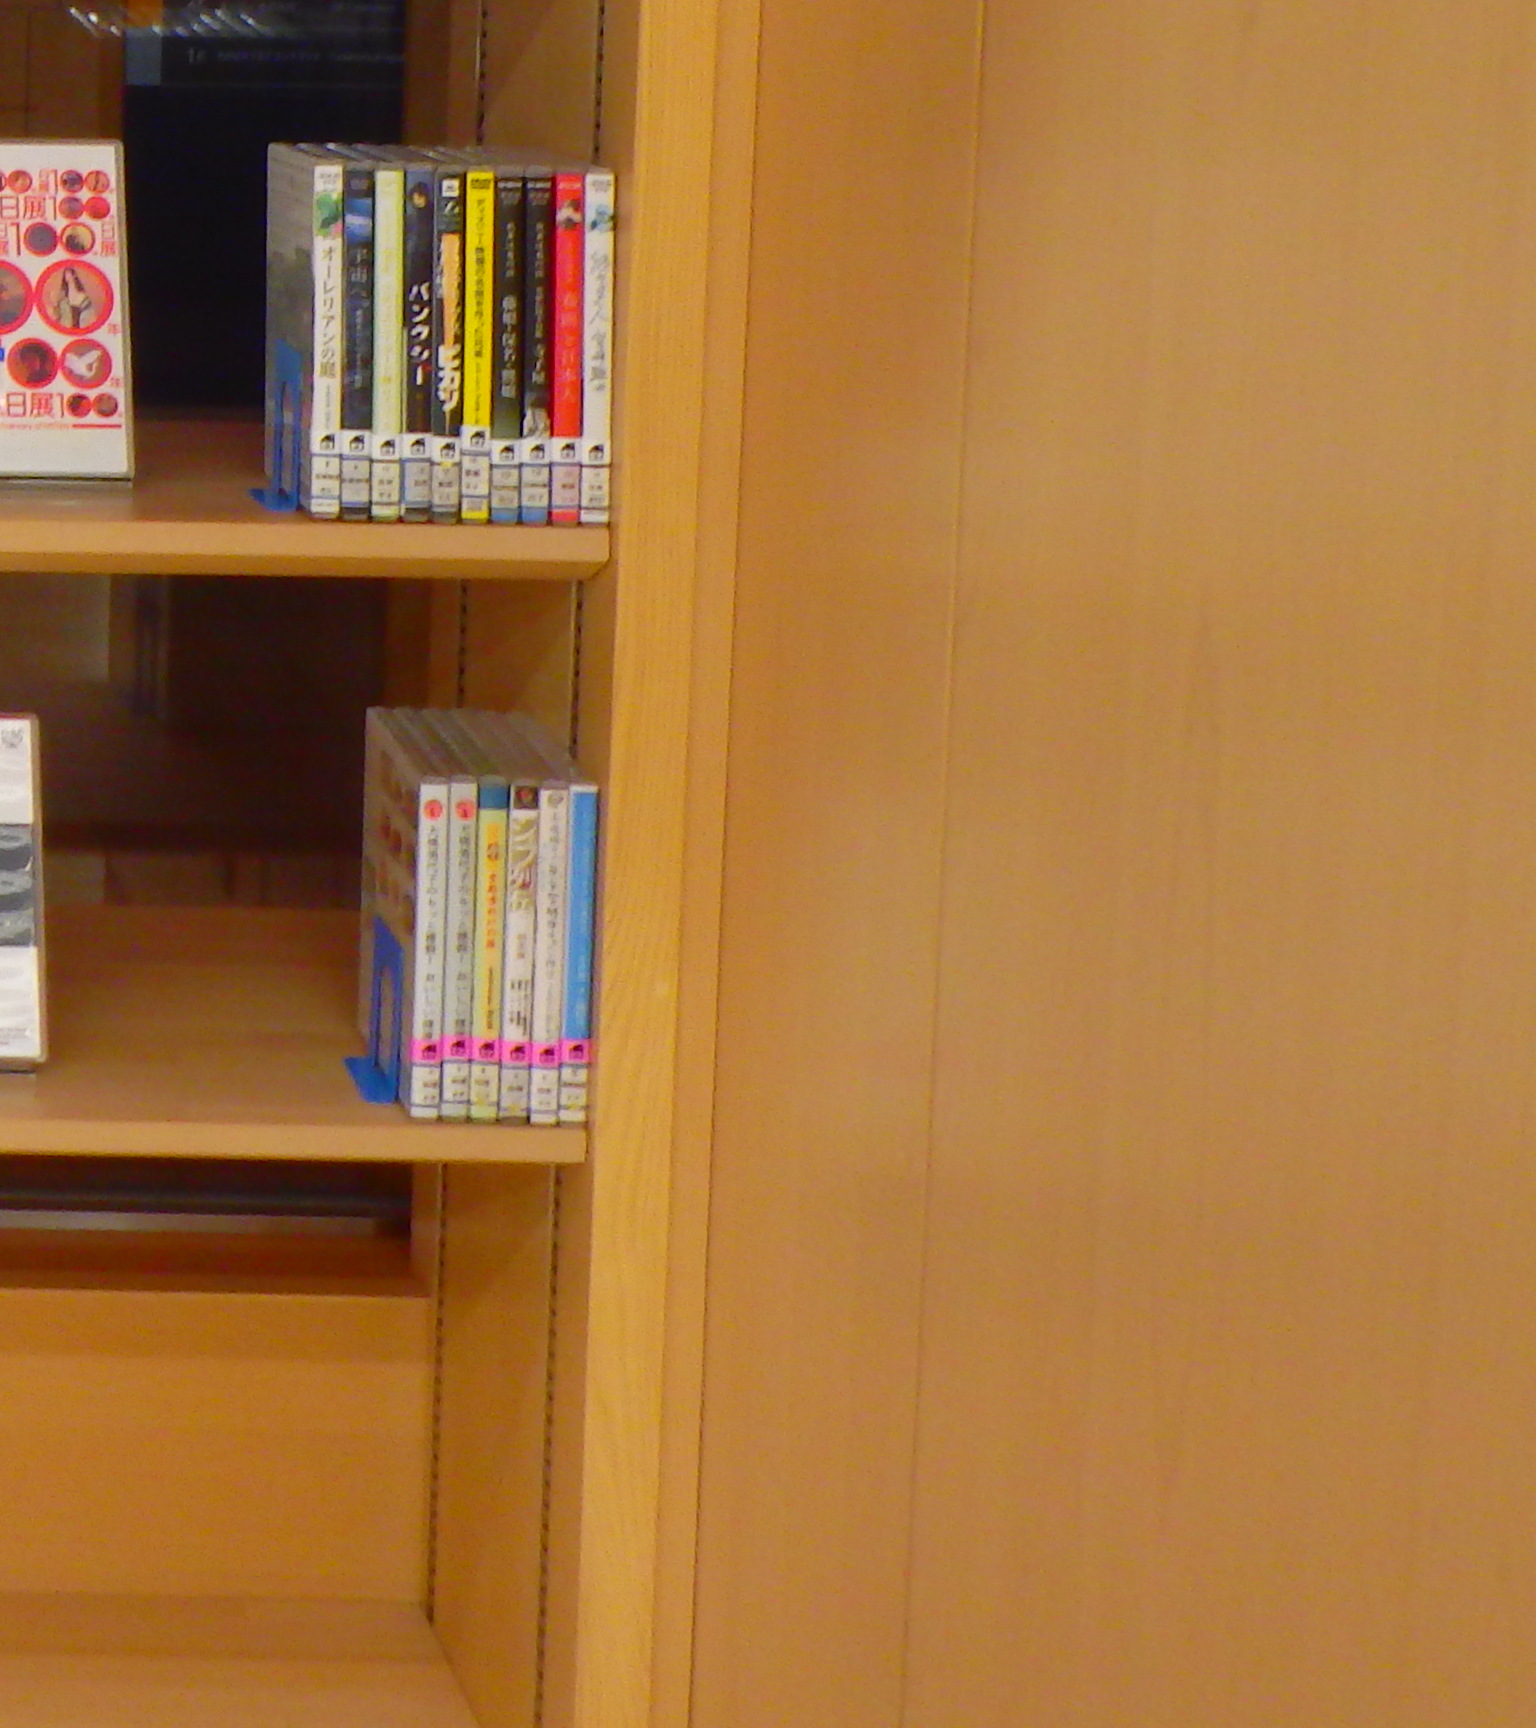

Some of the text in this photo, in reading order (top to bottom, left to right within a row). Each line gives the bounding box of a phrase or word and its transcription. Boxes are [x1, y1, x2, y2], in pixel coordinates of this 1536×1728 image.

[408, 279, 430, 386] バンクシー
